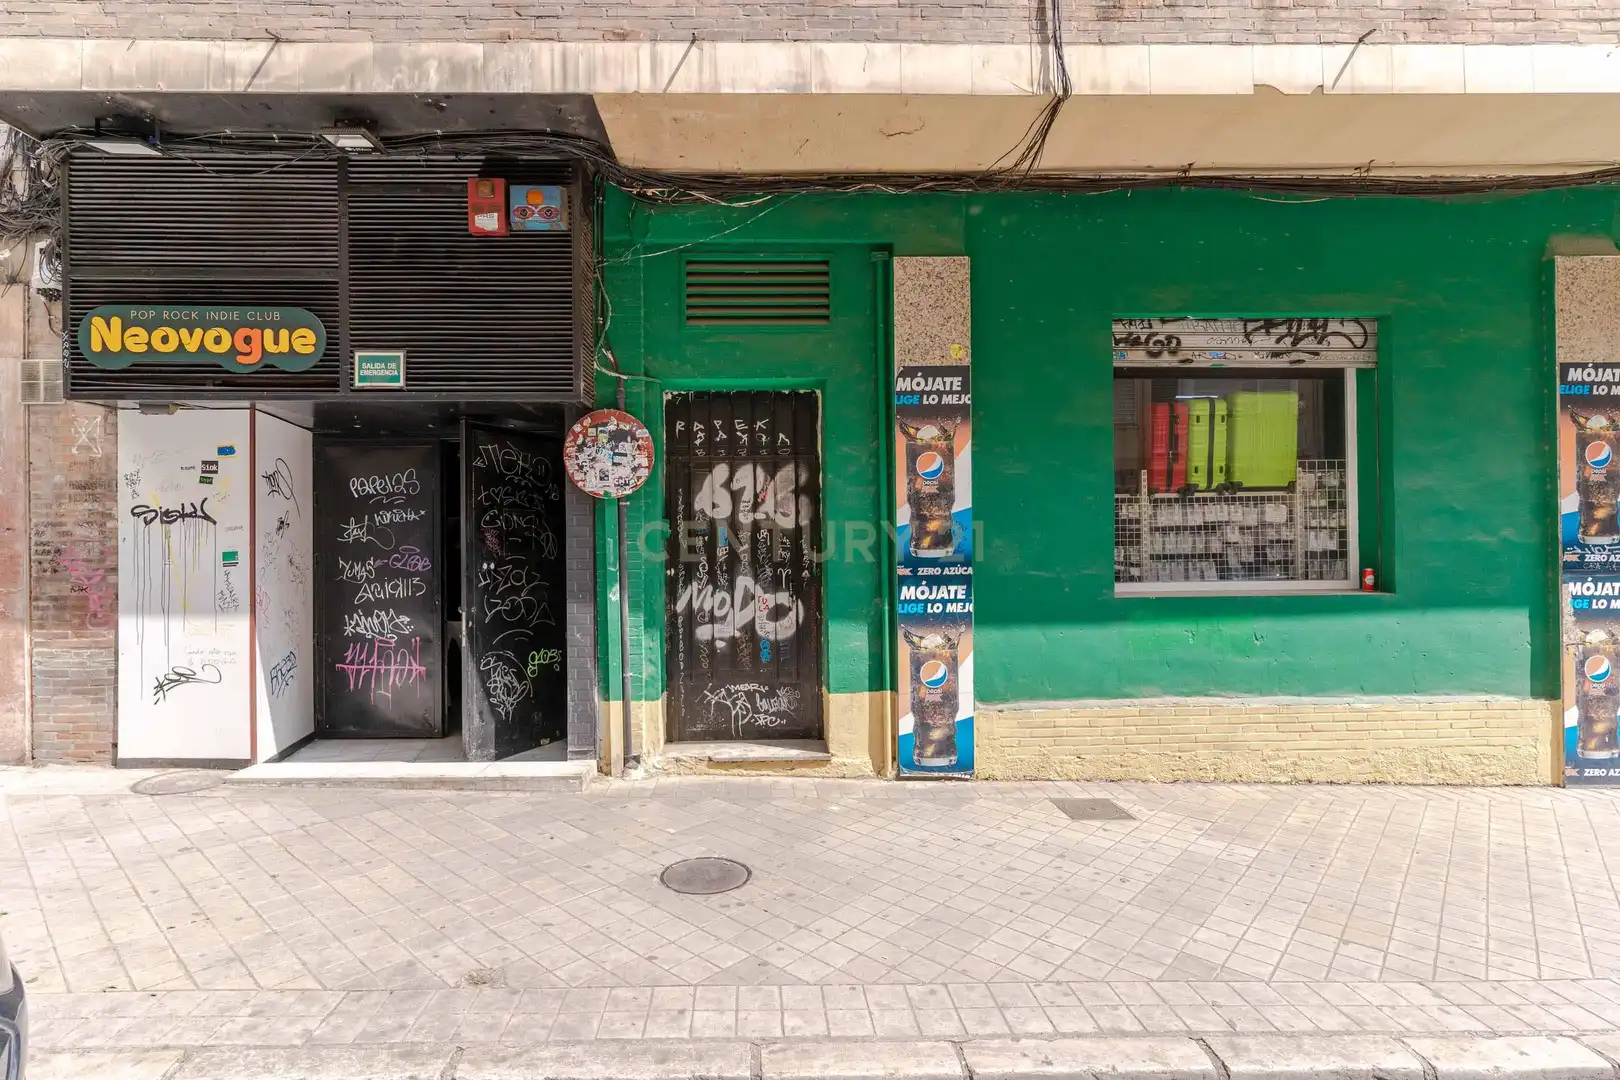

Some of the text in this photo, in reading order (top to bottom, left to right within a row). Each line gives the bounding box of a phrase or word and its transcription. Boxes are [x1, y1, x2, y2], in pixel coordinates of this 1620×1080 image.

[130, 310, 281, 321] POP ROCK INDIE CLUB
[91, 316, 317, 365] Neovogue
[361, 362, 397, 370] SALIDA DE
[896, 372, 962, 392] MÓJATE
[1560, 384, 1591, 395] ELIGE
[1592, 384, 1609, 396] LO
[922, 394, 939, 405] LO
[1584, 554, 1608, 562] ZERO
[917, 566, 942, 576] ZERO
[900, 580, 967, 600] MÓJATE
[927, 603, 943, 613] LO
[1592, 599, 1608, 609] LO
[1583, 768, 1607, 777] ZERO
